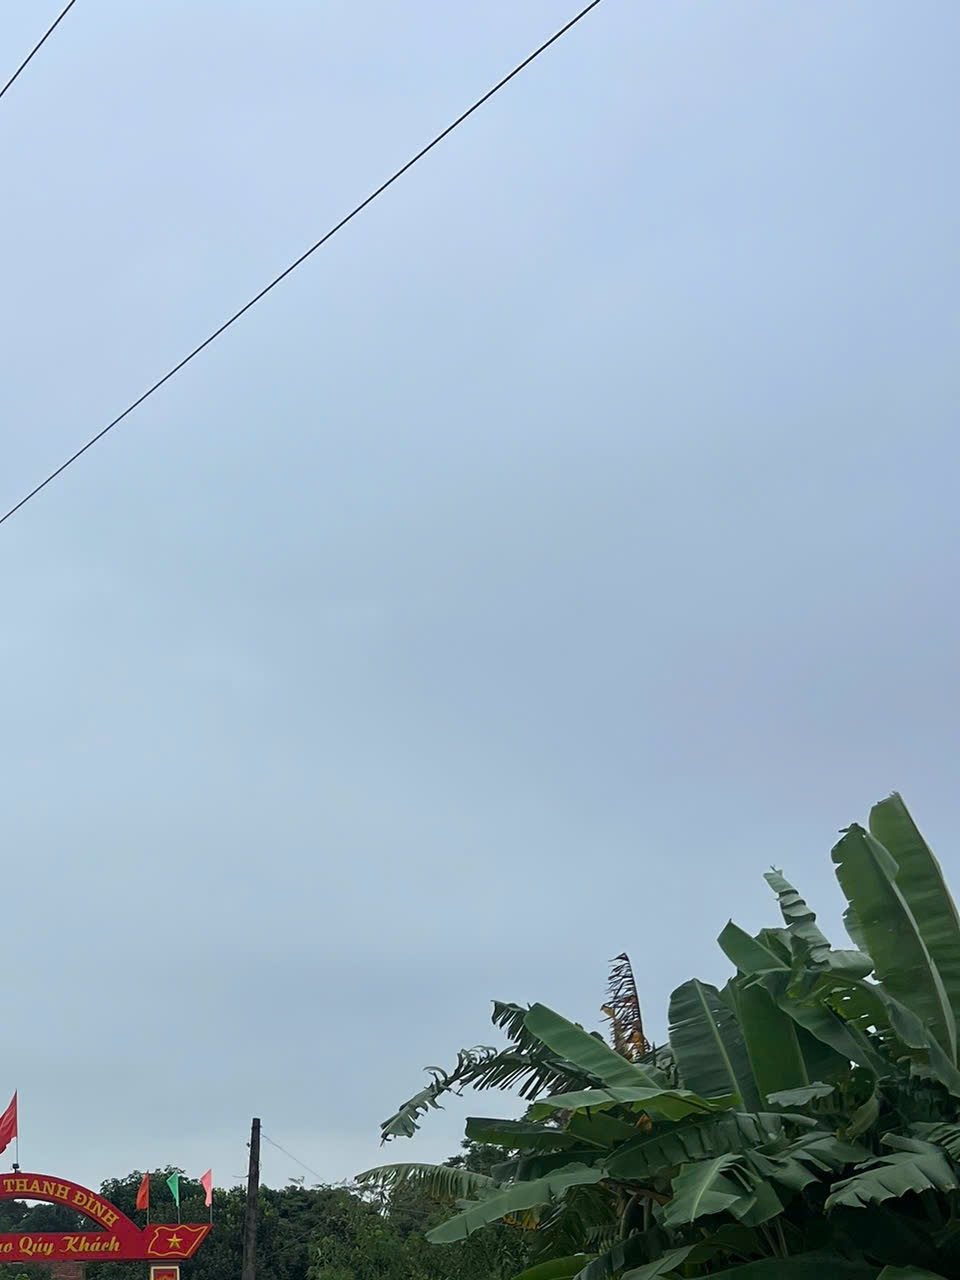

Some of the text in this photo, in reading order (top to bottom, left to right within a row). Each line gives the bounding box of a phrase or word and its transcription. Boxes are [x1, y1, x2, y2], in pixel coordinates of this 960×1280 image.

[3, 1179, 71, 1200] THANH
[72, 1191, 119, 1227] ĐÌNH
[59, 1236, 120, 1253] Khách
